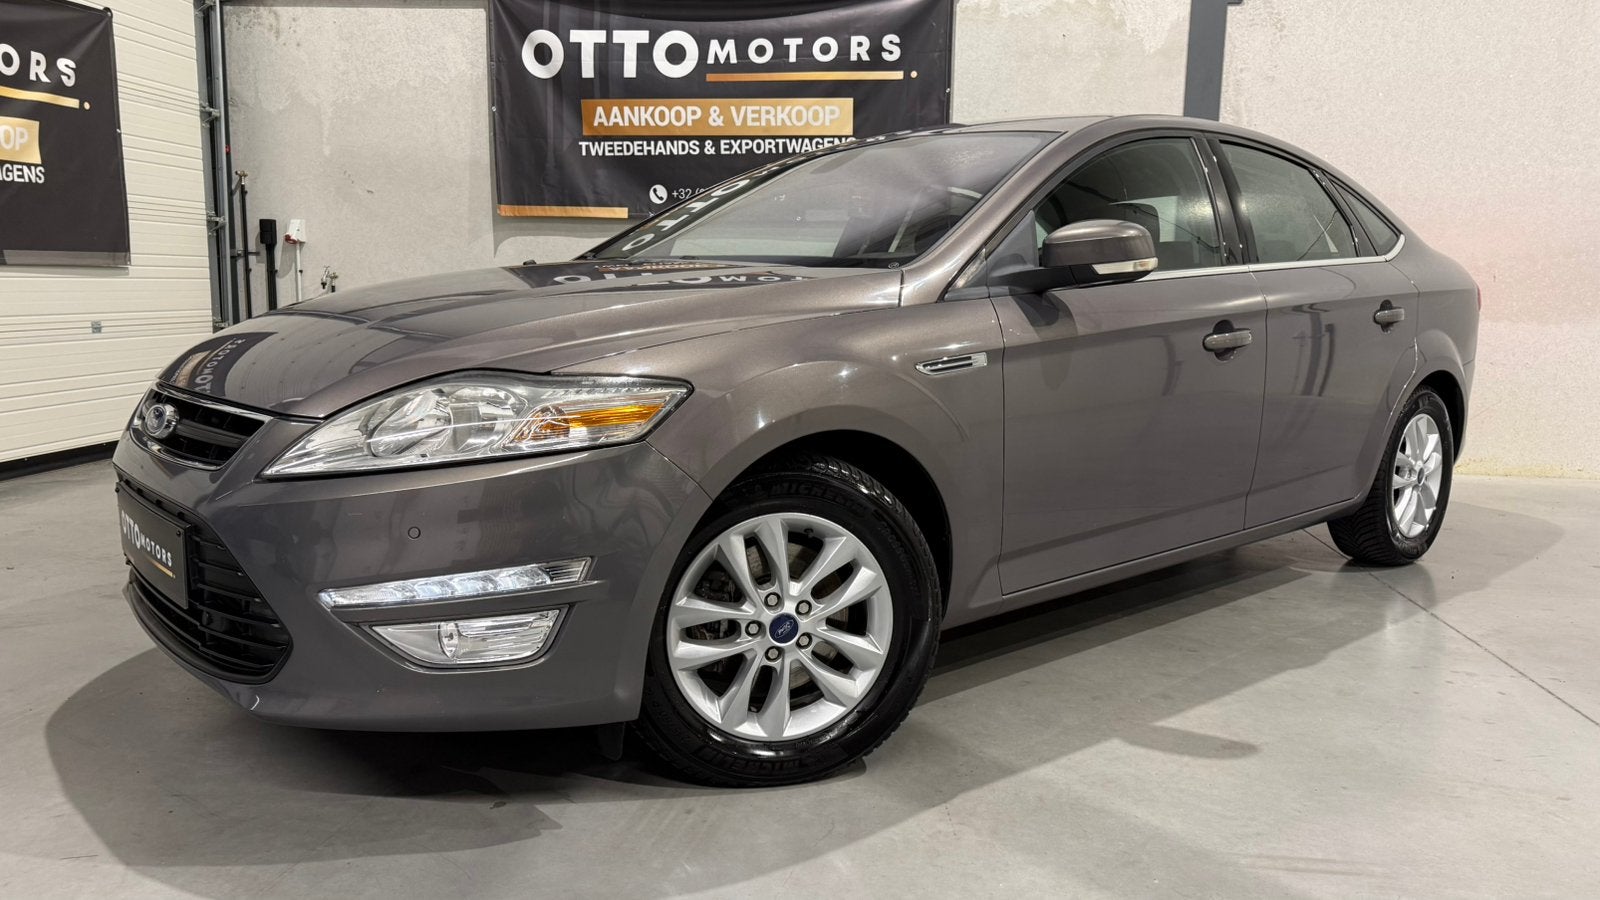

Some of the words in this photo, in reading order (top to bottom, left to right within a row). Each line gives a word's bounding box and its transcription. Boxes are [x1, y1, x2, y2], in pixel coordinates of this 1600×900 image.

[0, 43, 77, 87] ORS
[522, 29, 699, 79] OTTO
[706, 34, 902, 64] MOTORS
[593, 105, 702, 127] AANKOOP
[708, 106, 725, 127] &
[730, 105, 841, 127] VERKOOP
[578, 140, 700, 157] TWEEDEHANDS
[704, 140, 716, 155] &
[0, 163, 45, 184] GENS
[671, 188, 693, 200] +32
[121, 509, 141, 550] OTTO
[141, 532, 172, 568] MOTORS
